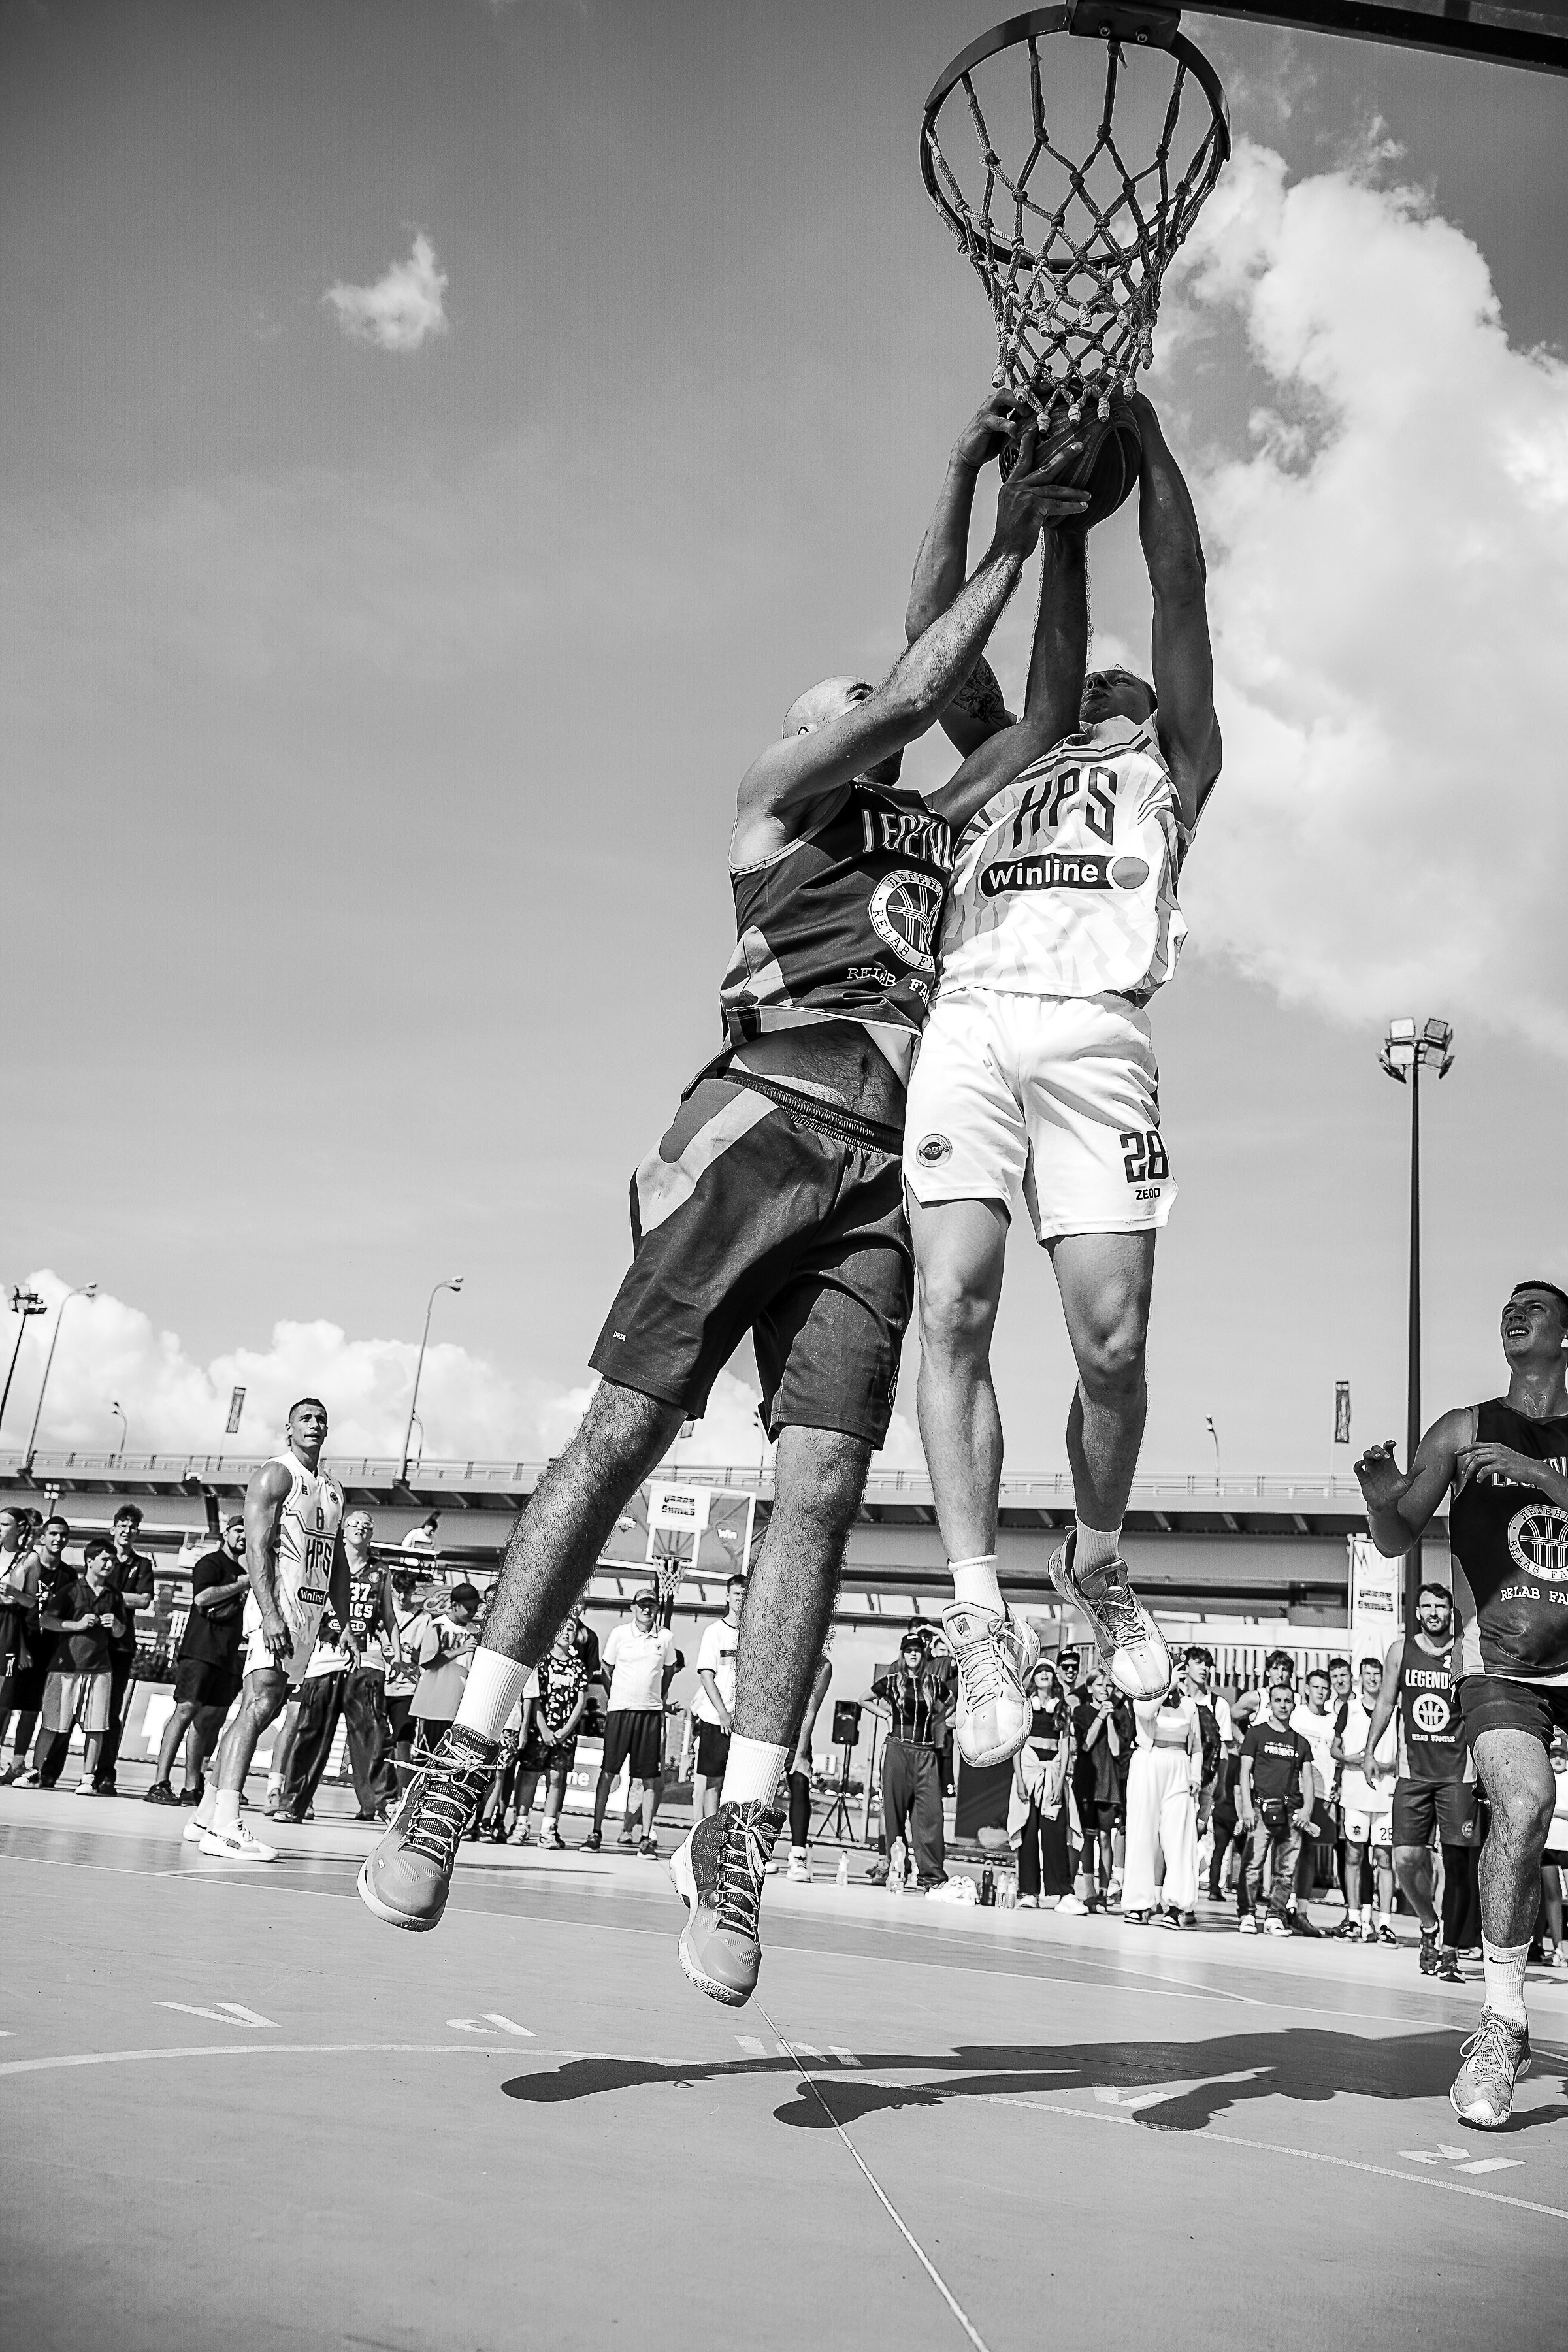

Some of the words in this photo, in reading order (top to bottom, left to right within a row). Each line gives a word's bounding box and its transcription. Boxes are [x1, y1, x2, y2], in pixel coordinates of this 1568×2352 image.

[1012, 766, 1118, 849] HPS
[908, 978, 931, 1010] FA
[1119, 1130, 1169, 1183] 28
[1135, 1188, 1160, 1200] ZEDO
[306, 1539, 333, 1578] HPS
[1501, 1586, 1540, 1601] RELAB
[1549, 1590, 1568, 1605] FA
